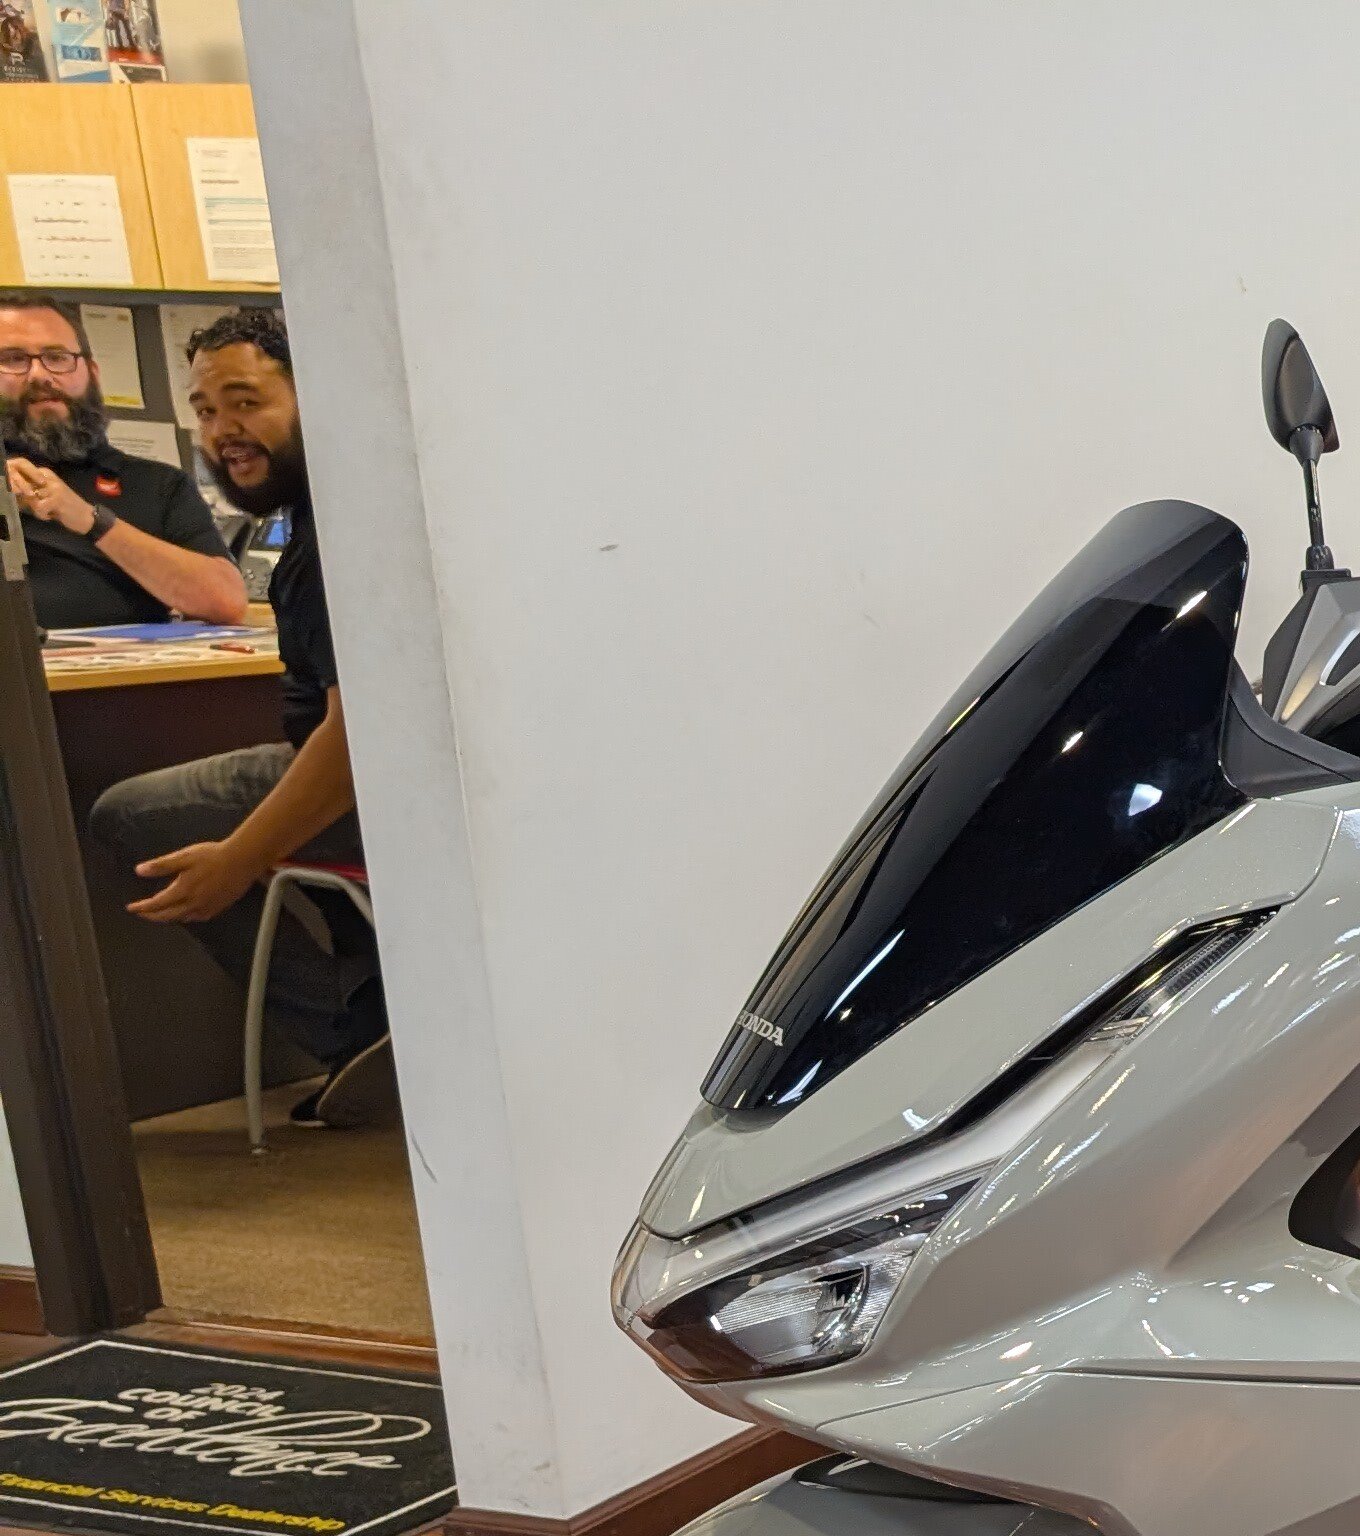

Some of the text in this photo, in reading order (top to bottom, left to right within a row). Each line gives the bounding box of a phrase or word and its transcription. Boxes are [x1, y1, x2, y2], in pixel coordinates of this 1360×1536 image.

[117, 1387, 286, 1418] COUNCIL
[190, 1382, 286, 1402] 2024
[142, 1406, 208, 1423] OF
[99, 1489, 209, 1513] Services
